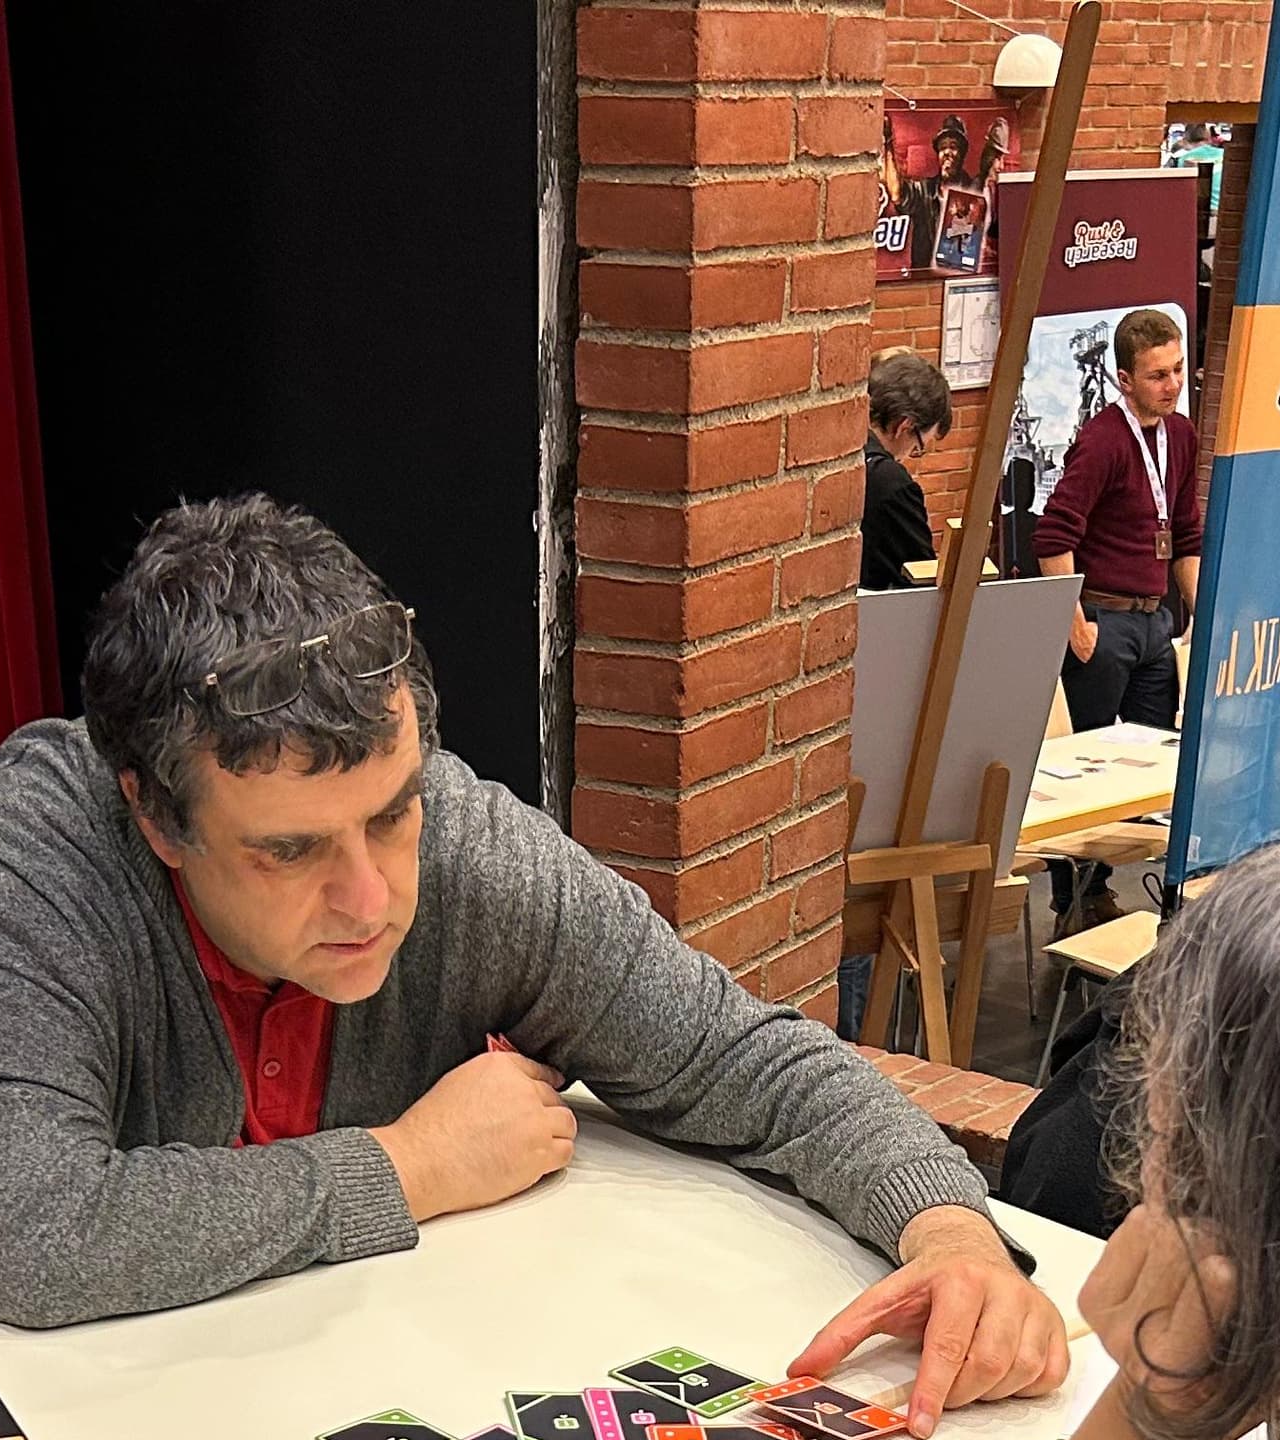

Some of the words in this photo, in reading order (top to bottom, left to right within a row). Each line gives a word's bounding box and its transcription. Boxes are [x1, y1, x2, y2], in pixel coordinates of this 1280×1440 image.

[874, 215, 909, 251] Re
[1074, 221, 1110, 246] Rust
[1110, 220, 1125, 241] &
[1065, 238, 1137, 267] Research
